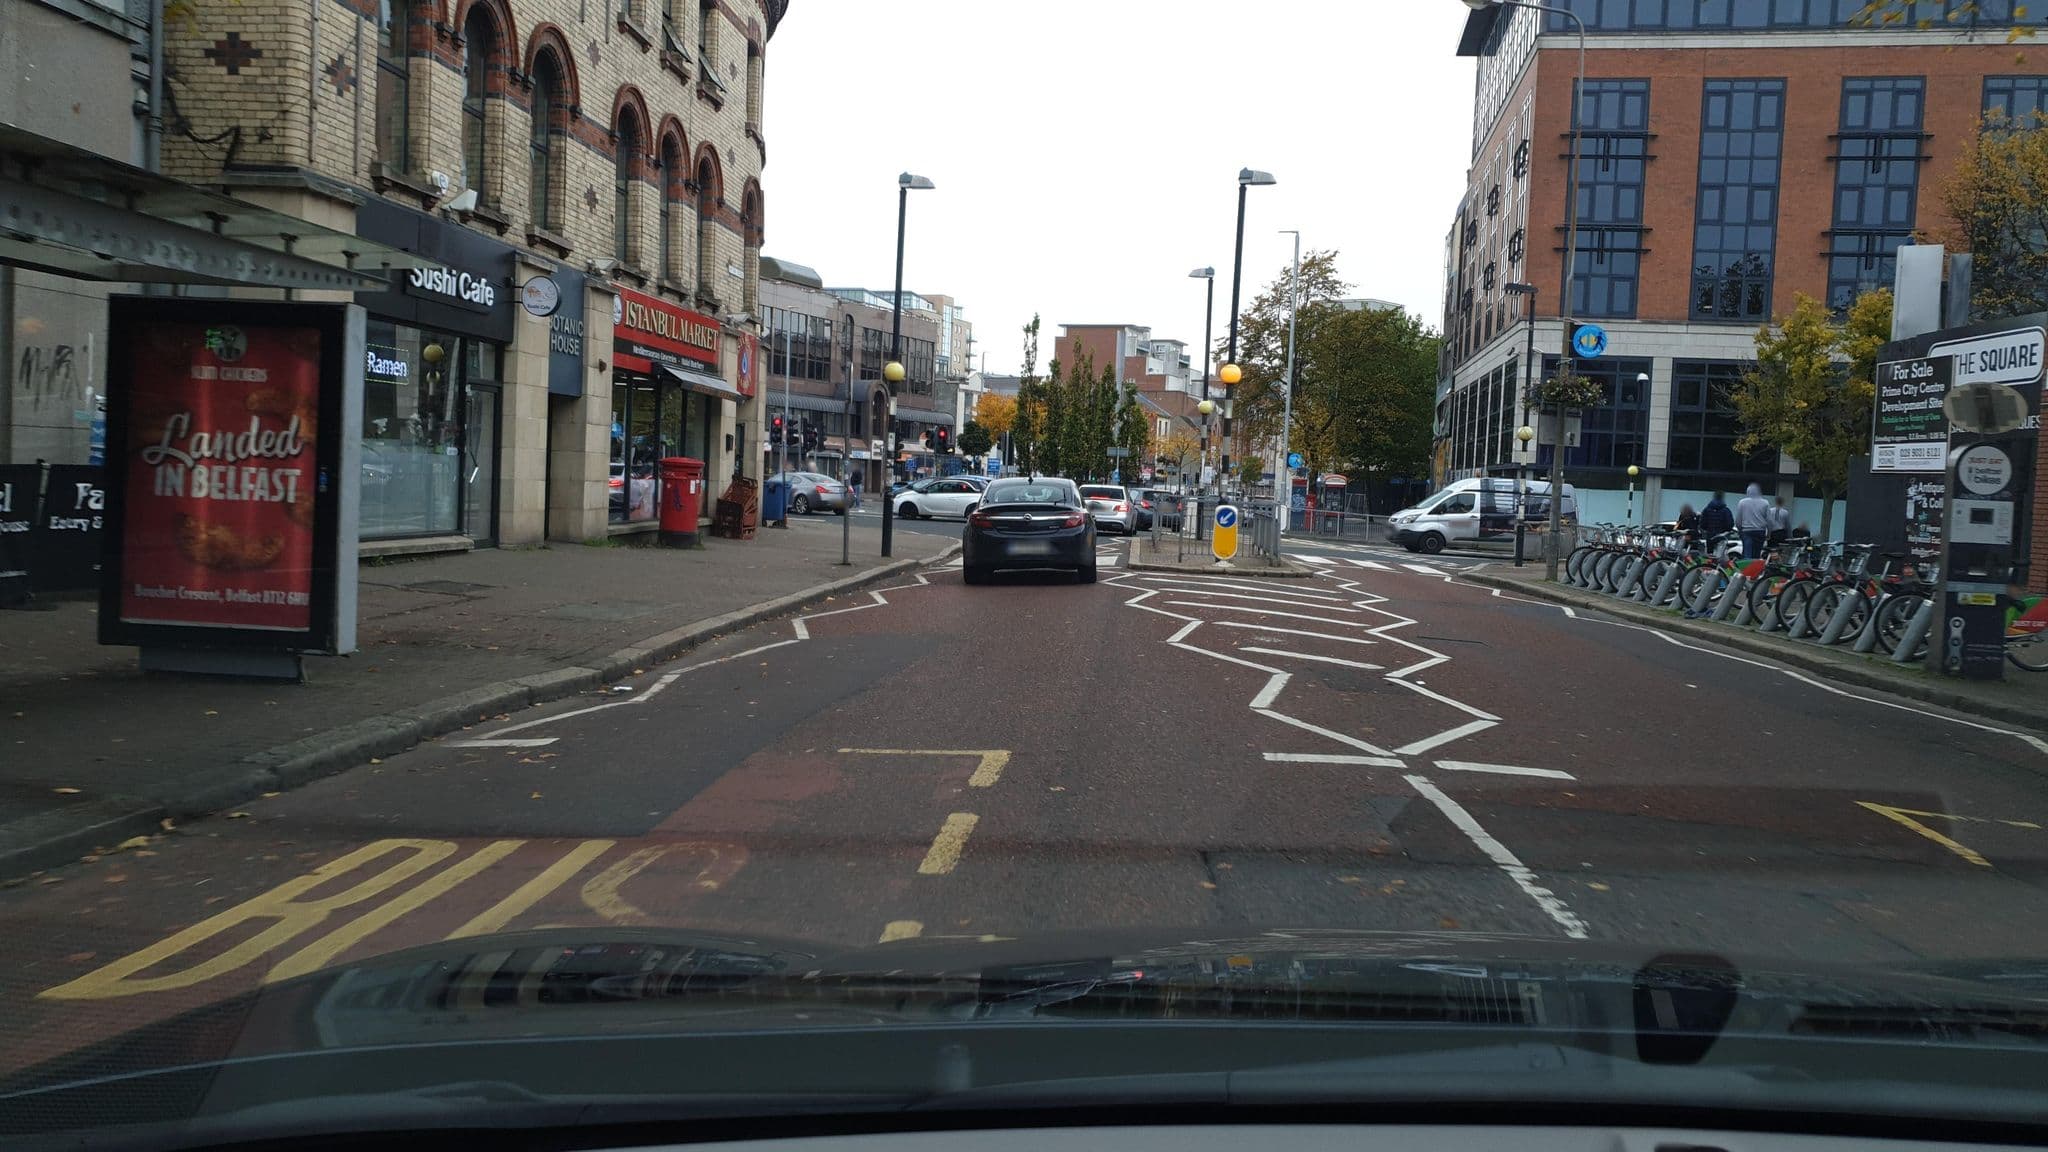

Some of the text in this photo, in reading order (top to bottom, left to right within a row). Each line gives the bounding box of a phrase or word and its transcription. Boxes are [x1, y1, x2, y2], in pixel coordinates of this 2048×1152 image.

[410, 268, 495, 307] Sushi Cafe
[624, 300, 679, 340] ISTANBUL
[680, 318, 719, 351] MARKET
[551, 333, 580, 355] HOUSE
[1979, 342, 2039, 373] SQUARE
[367, 351, 407, 378] Ramen
[1893, 361, 1934, 380] For Sale
[1882, 382, 1945, 397] Prime City Centre
[1882, 400, 1928, 413] Development
[142, 412, 303, 468] Landed
[155, 462, 302, 503] IN BELFAST
